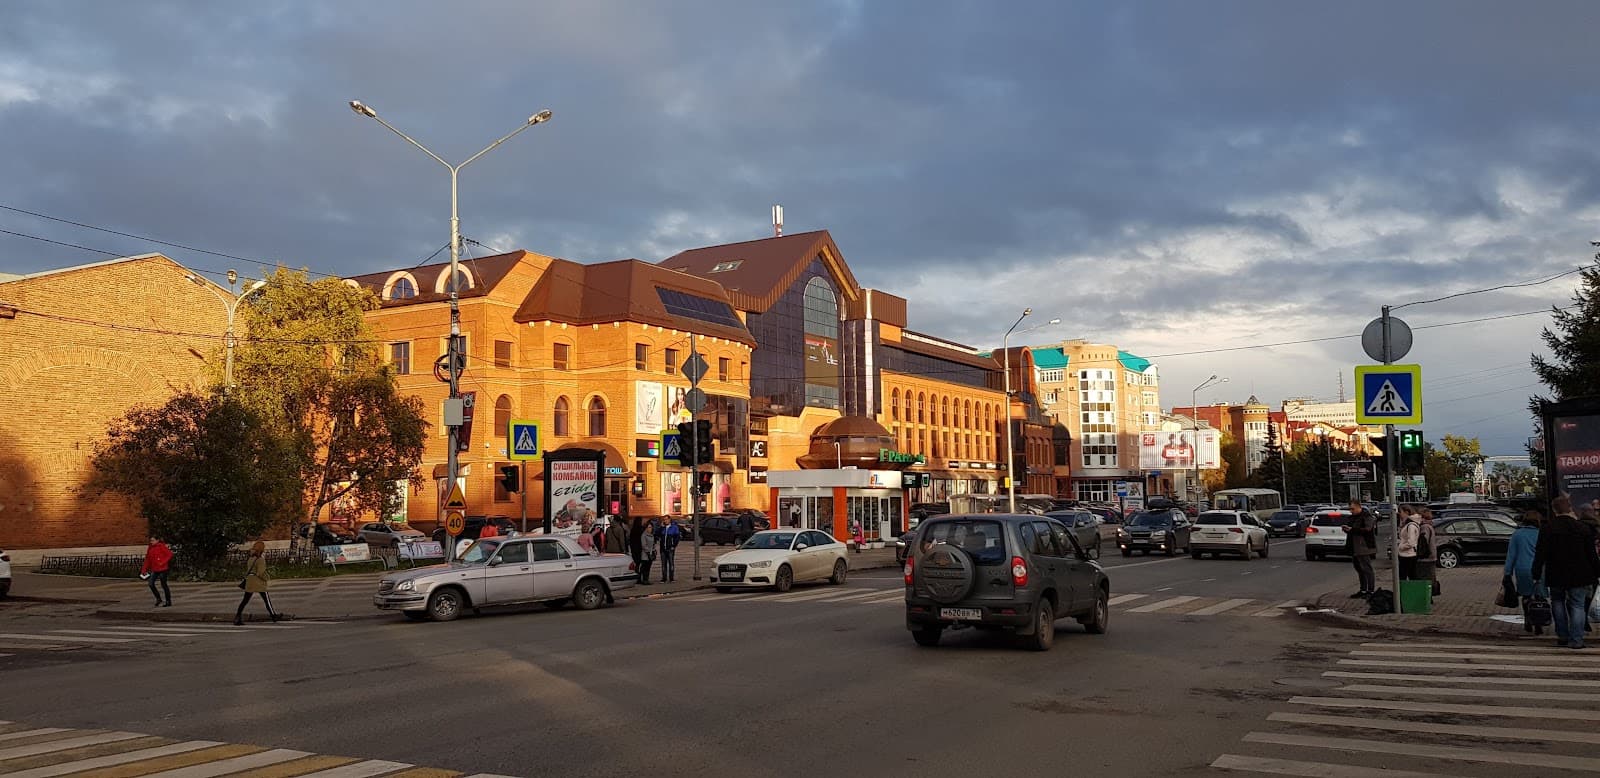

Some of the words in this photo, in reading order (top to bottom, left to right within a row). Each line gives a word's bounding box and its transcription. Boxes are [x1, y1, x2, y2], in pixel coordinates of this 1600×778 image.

[1404, 434, 1419, 447] 21
[553, 462, 596, 471] СУШИЛЬНЫЕ
[1559, 456, 1600, 467] ТАРИФ
[552, 471, 596, 481] КОМБАЙНЫ
[553, 481, 596, 497] ezidri
[449, 518, 461, 528] 40
